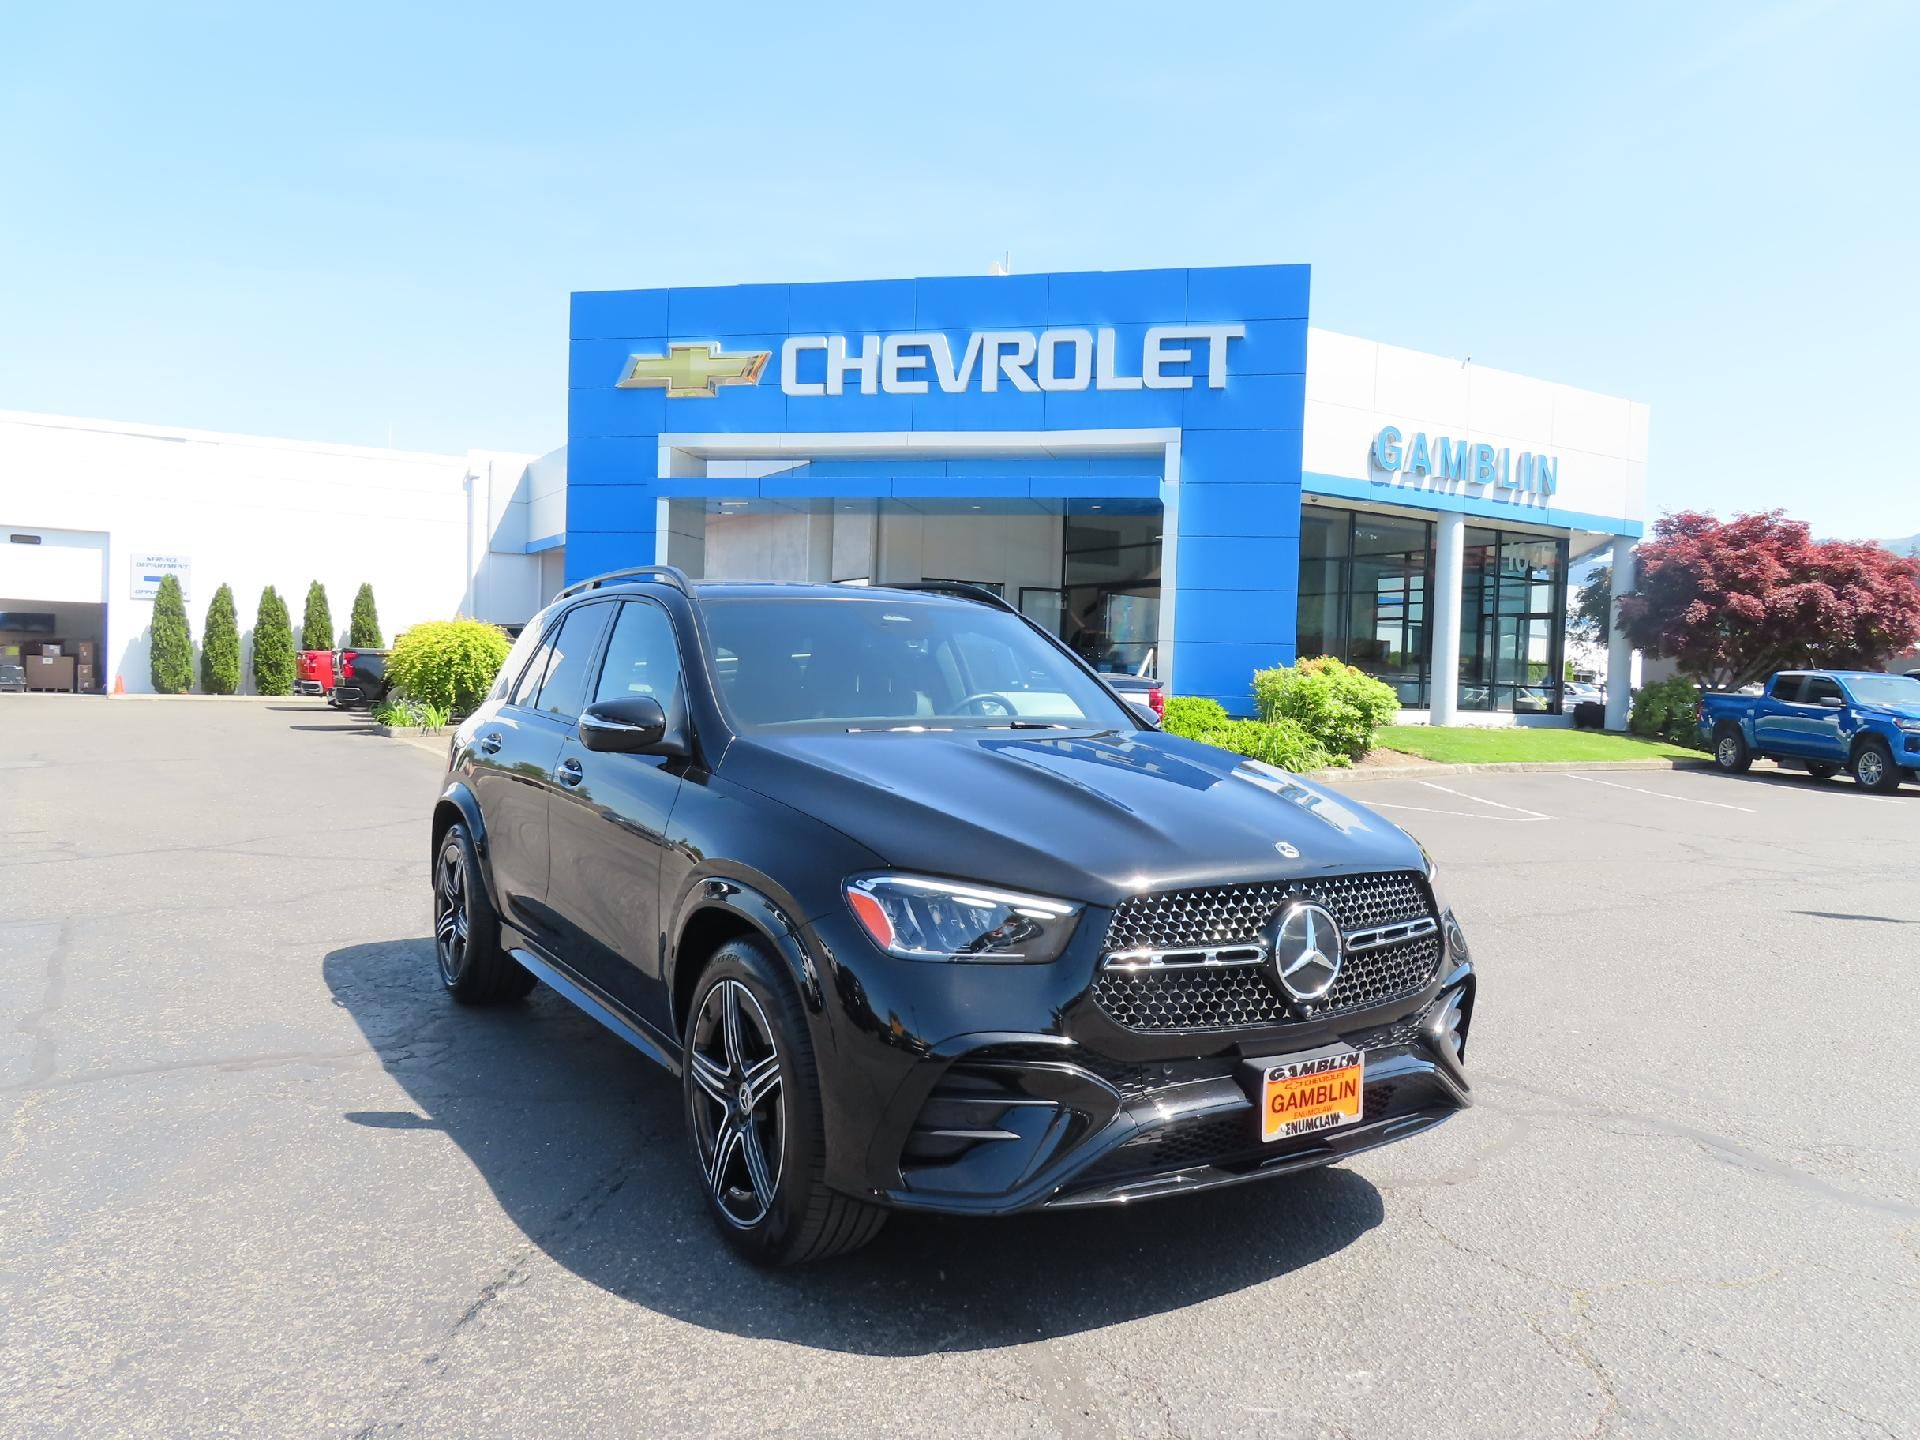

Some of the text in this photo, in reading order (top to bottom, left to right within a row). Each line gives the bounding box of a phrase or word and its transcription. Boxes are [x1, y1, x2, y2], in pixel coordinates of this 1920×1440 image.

[781, 325, 1246, 396] CHEVROLET
[1374, 426, 1558, 496] GAMBLIN
[1269, 1053, 1360, 1081] GAMBLIN
[1271, 1078, 1357, 1113] GAMBLIN
[1285, 1112, 1341, 1136] ENUMCLAW
